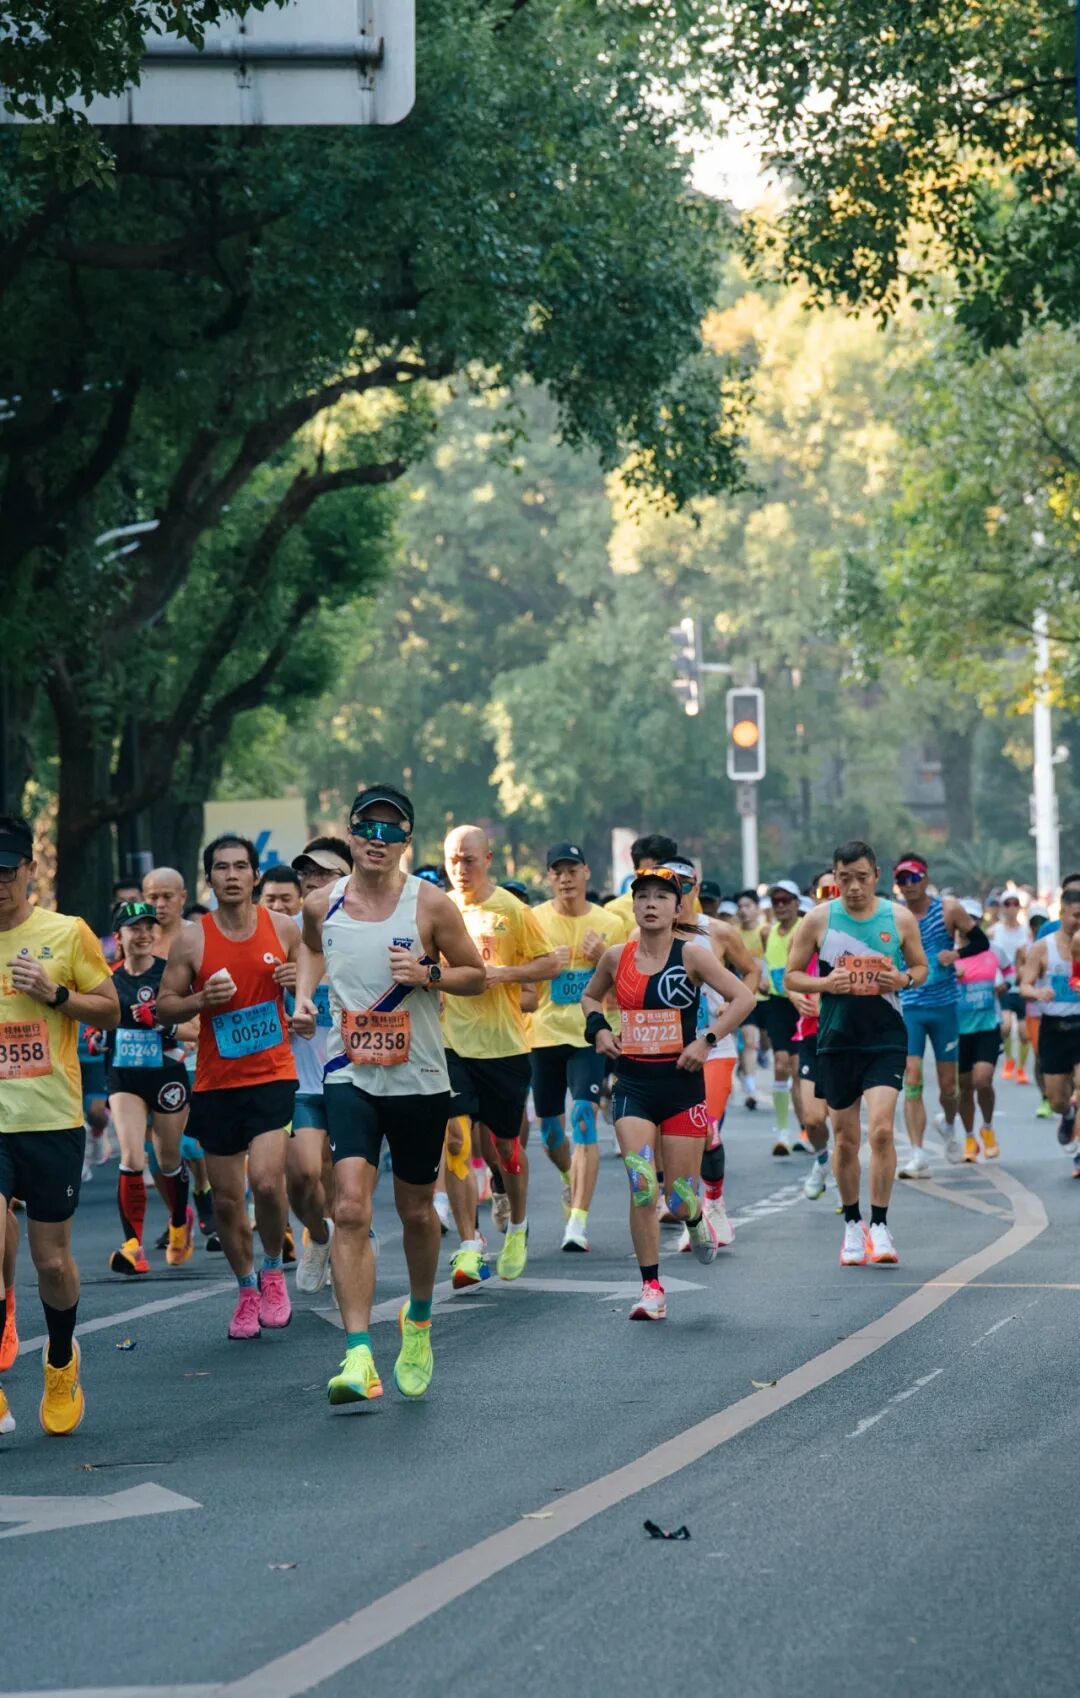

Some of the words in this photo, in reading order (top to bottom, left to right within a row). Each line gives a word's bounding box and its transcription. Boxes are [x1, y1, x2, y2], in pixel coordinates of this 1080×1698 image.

[232, 1019, 277, 1044] 00526
[350, 1031, 405, 1050] 02358
[633, 1024, 677, 1041] 02722
